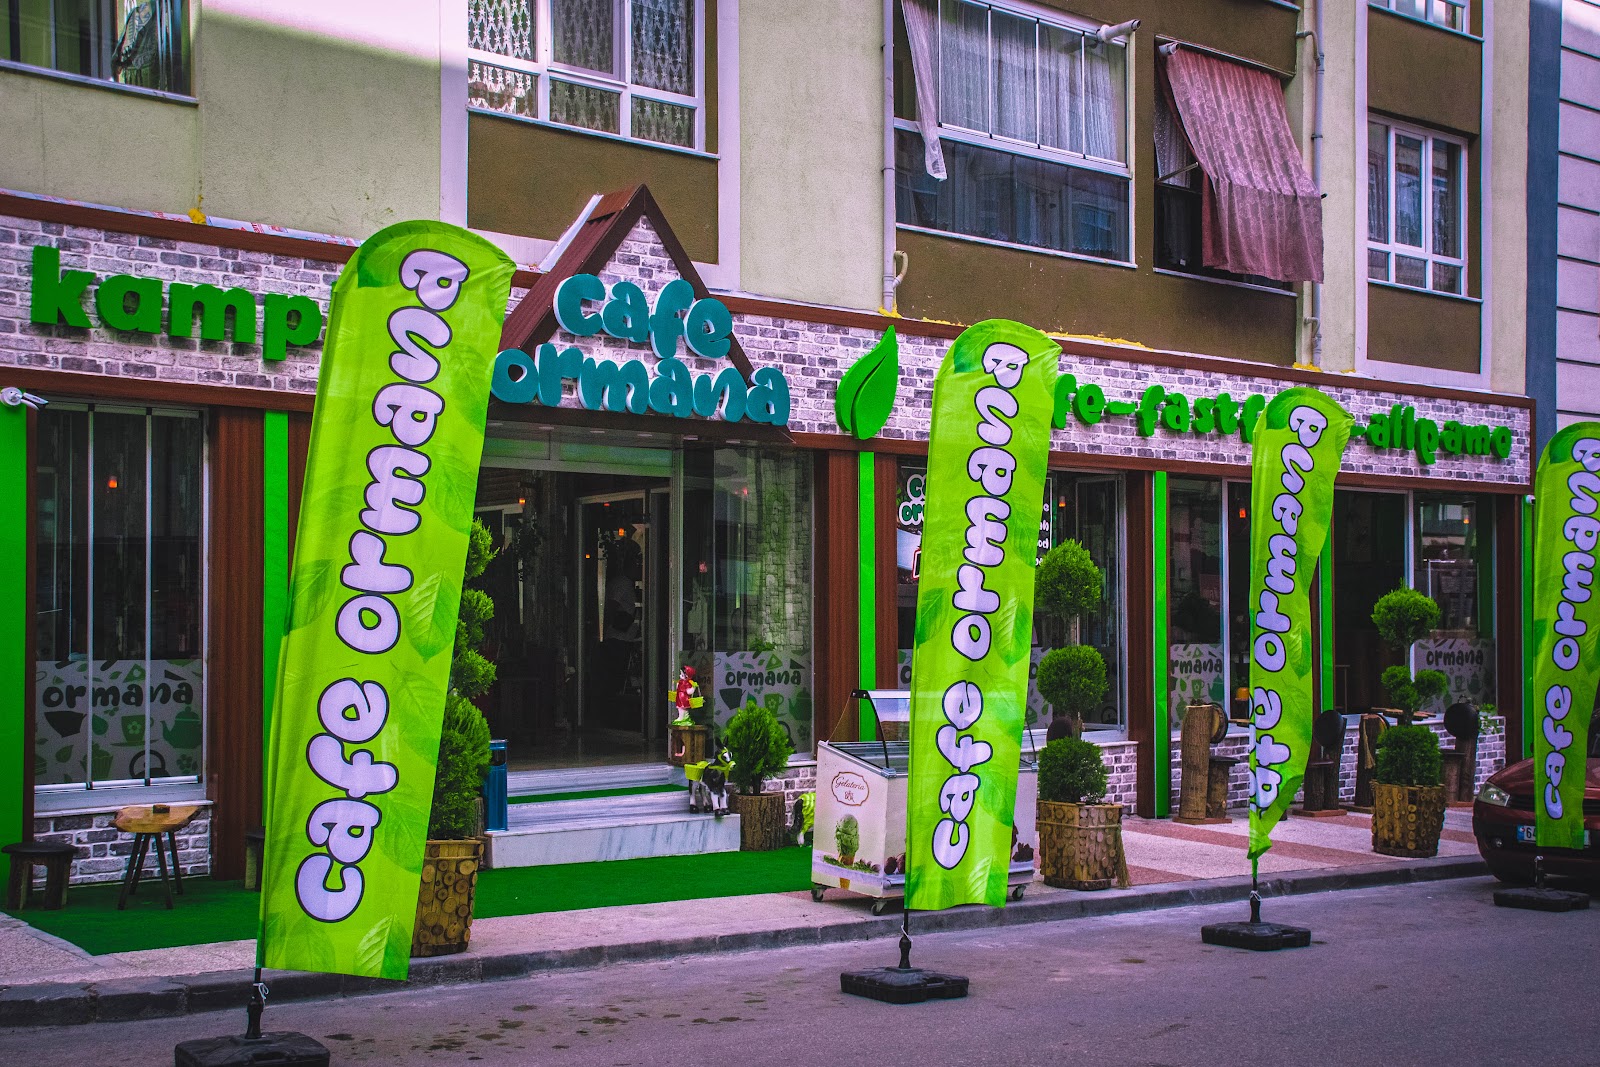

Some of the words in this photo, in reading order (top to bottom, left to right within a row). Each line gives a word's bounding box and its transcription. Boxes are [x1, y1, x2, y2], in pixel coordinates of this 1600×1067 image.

[335, 248, 471, 654] ormana
[491, 343, 790, 426] ormana
[951, 342, 1030, 661] ormana
[1253, 405, 1328, 673] ormana
[42, 682, 194, 709] ormana
[725, 670, 802, 687] ormana
[1171, 658, 1223, 675] rmana
[1426, 649, 1484, 667] ormana
[294, 677, 400, 922] cafe
[931, 680, 993, 870] cafe
